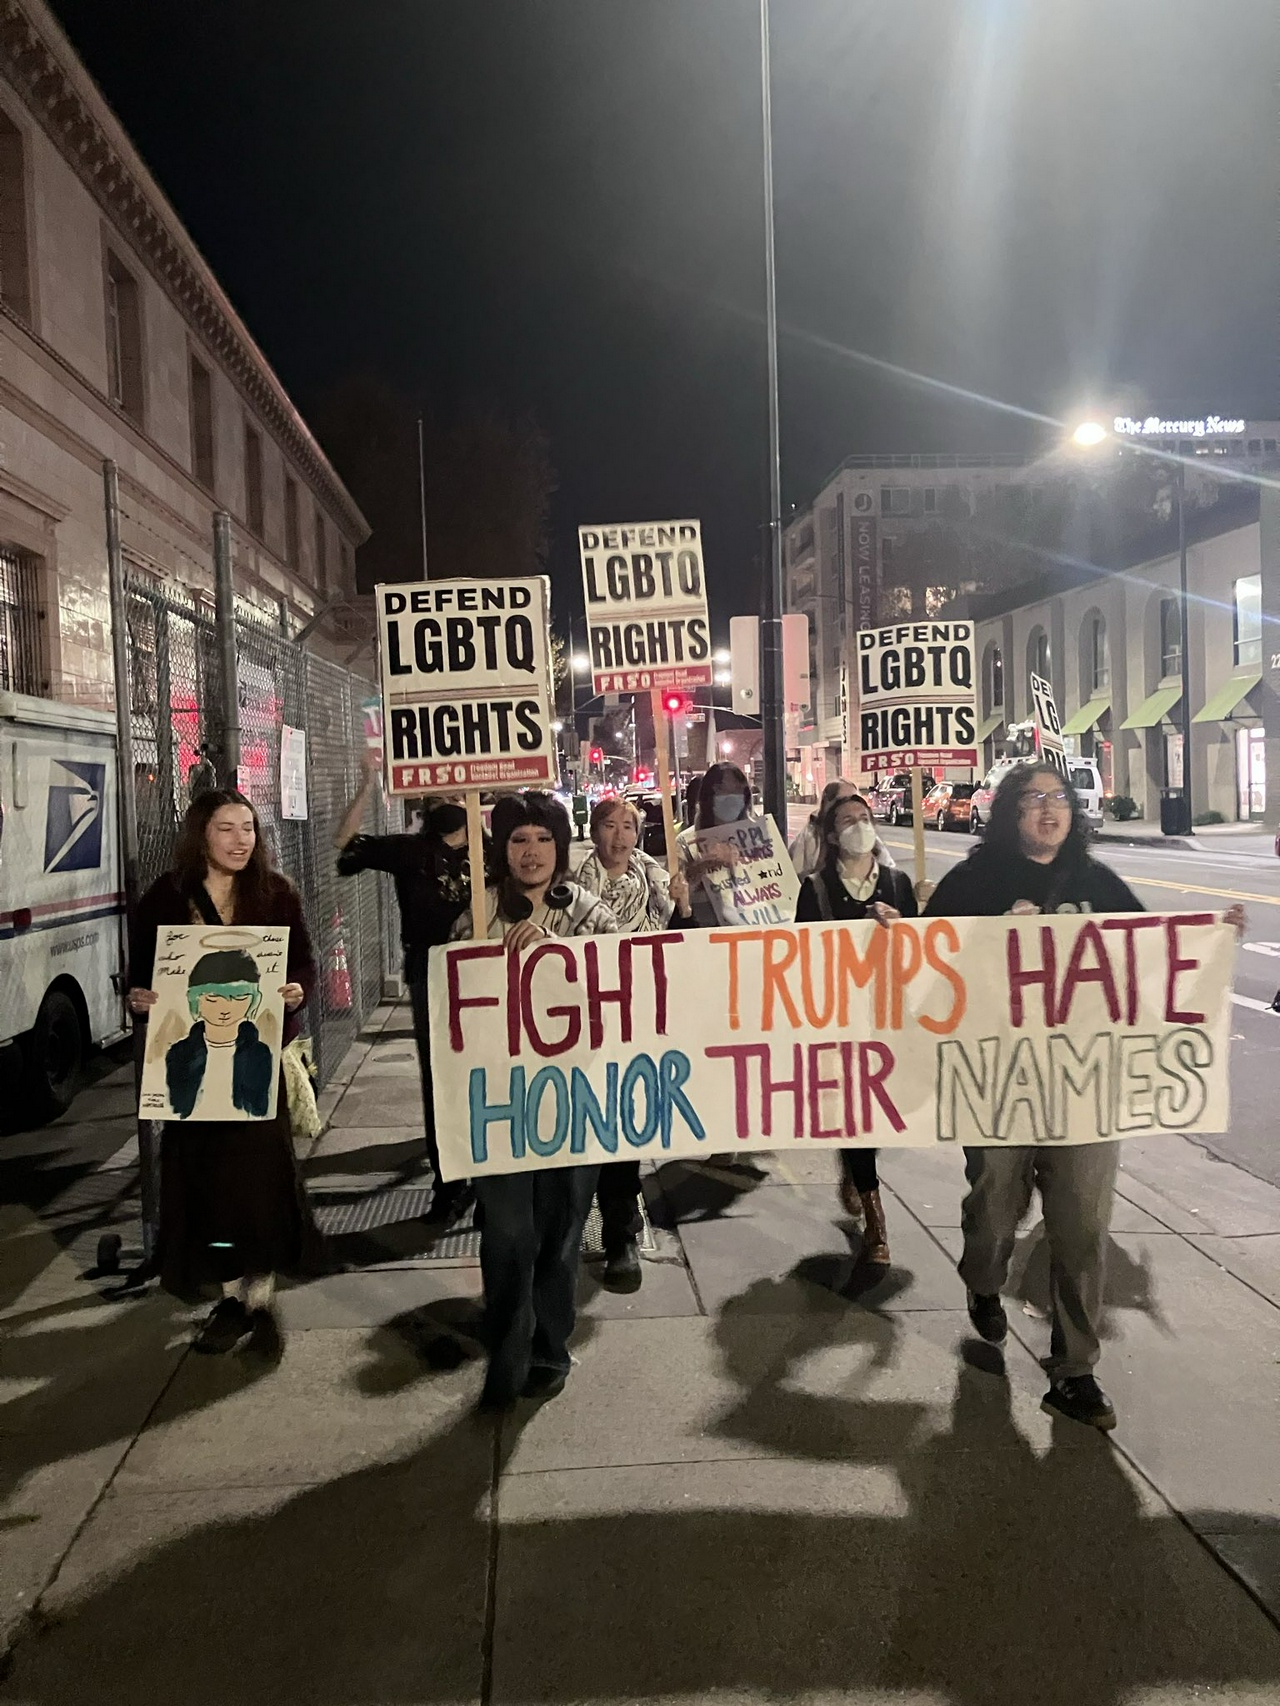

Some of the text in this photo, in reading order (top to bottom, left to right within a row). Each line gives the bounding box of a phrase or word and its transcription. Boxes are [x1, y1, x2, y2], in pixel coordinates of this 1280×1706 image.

[1113, 416, 1245, 437] The Mercury News
[582, 525, 697, 551] DEFEND
[585, 551, 702, 603] LGBTQ
[859, 521, 872, 630] NOW LEASING
[385, 586, 531, 615] DEFEND
[387, 614, 536, 676] LGBTQ
[590, 618, 709, 669] RIGHTS
[860, 625, 970, 650] DEFEND
[601, 672, 651, 691] FRSO
[861, 645, 972, 695] LGBTQ
[391, 700, 542, 760] RIGHTS
[861, 706, 975, 751] RIGHTS
[402, 764, 466, 786] FRSO
[867, 753, 915, 770] FRSO
[733, 883, 782, 908] ALWAYS
[739, 904, 791, 925] WILL
[265, 961, 280, 974] it
[446, 914, 1214, 1058] FIGHT TRUMPS HATE
[468, 1026, 1214, 1164] HONOR THEIR NAMES
